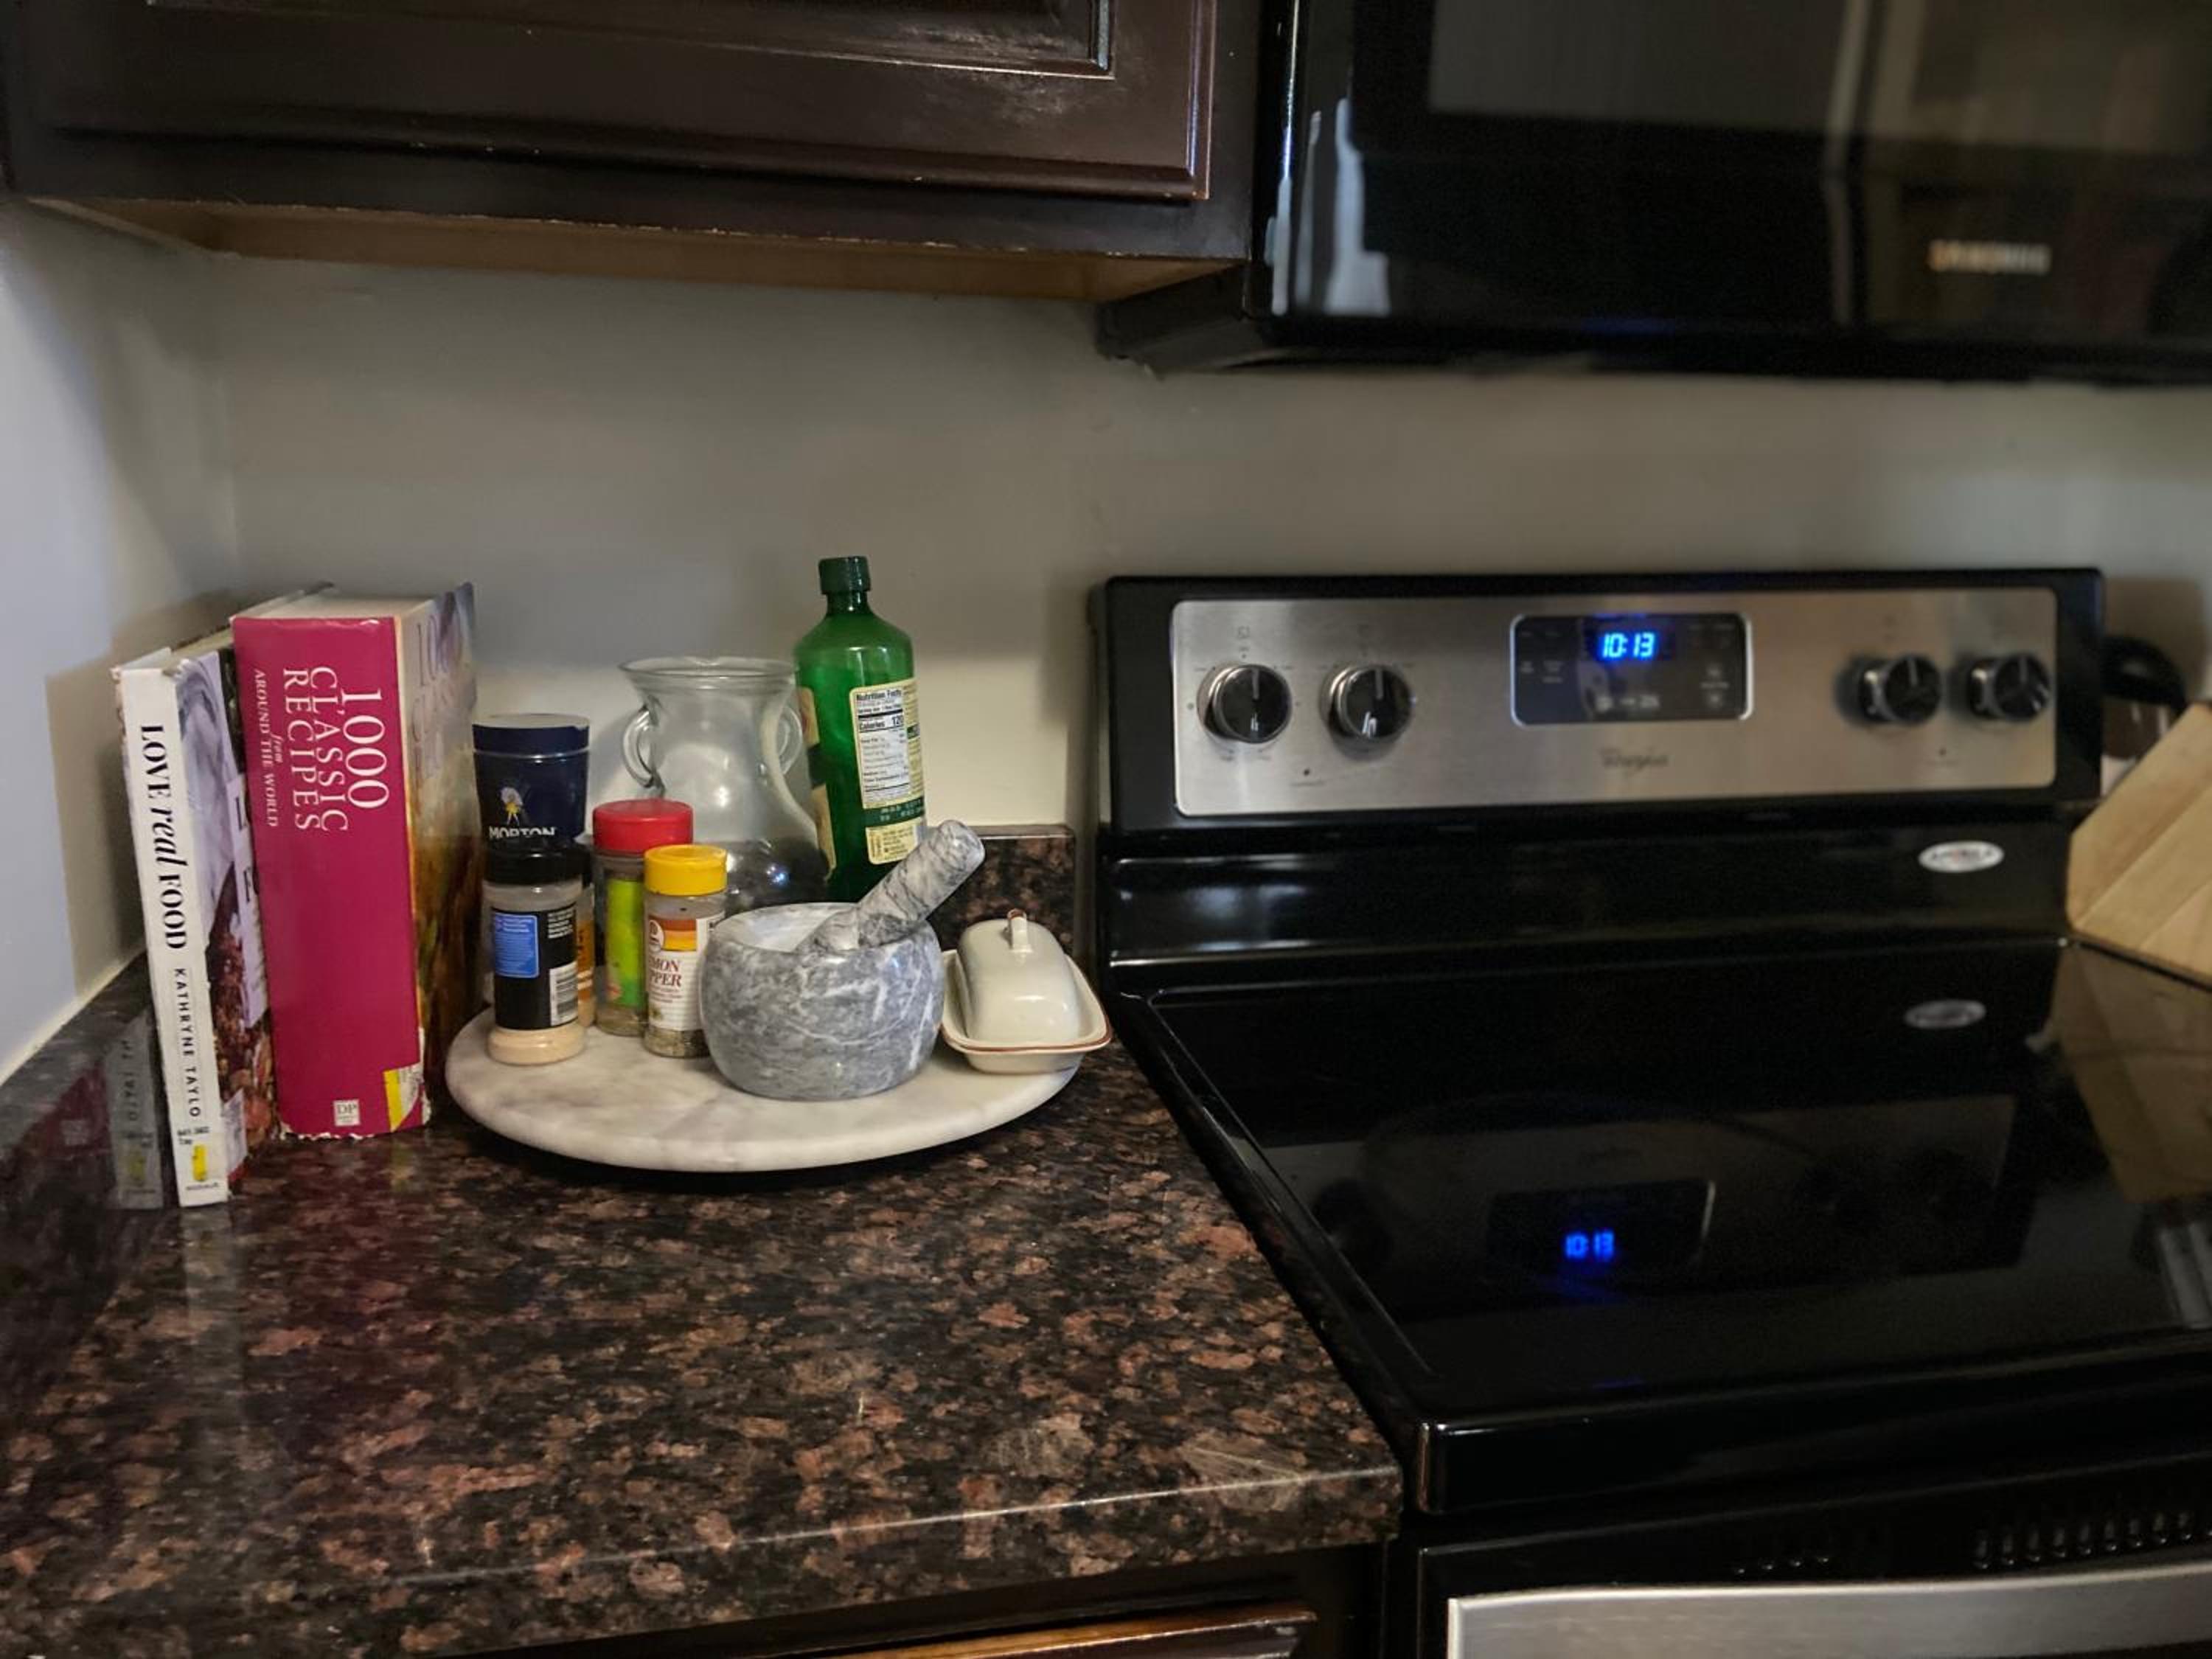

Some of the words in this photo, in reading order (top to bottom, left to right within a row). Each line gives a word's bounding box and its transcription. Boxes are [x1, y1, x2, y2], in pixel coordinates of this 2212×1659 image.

[1602, 632, 1655, 658] 10:13
[254, 669, 271, 734] AROUND
[141, 726, 170, 799] LOVE
[261, 740, 274, 768] THE
[283, 668, 320, 830] RECIPES
[310, 666, 349, 832] CLASSIC
[264, 773, 278, 827] WORLD
[150, 807, 188, 866] real
[159, 874, 186, 948] FOOD
[174, 968, 195, 1057] KATHRYNE
